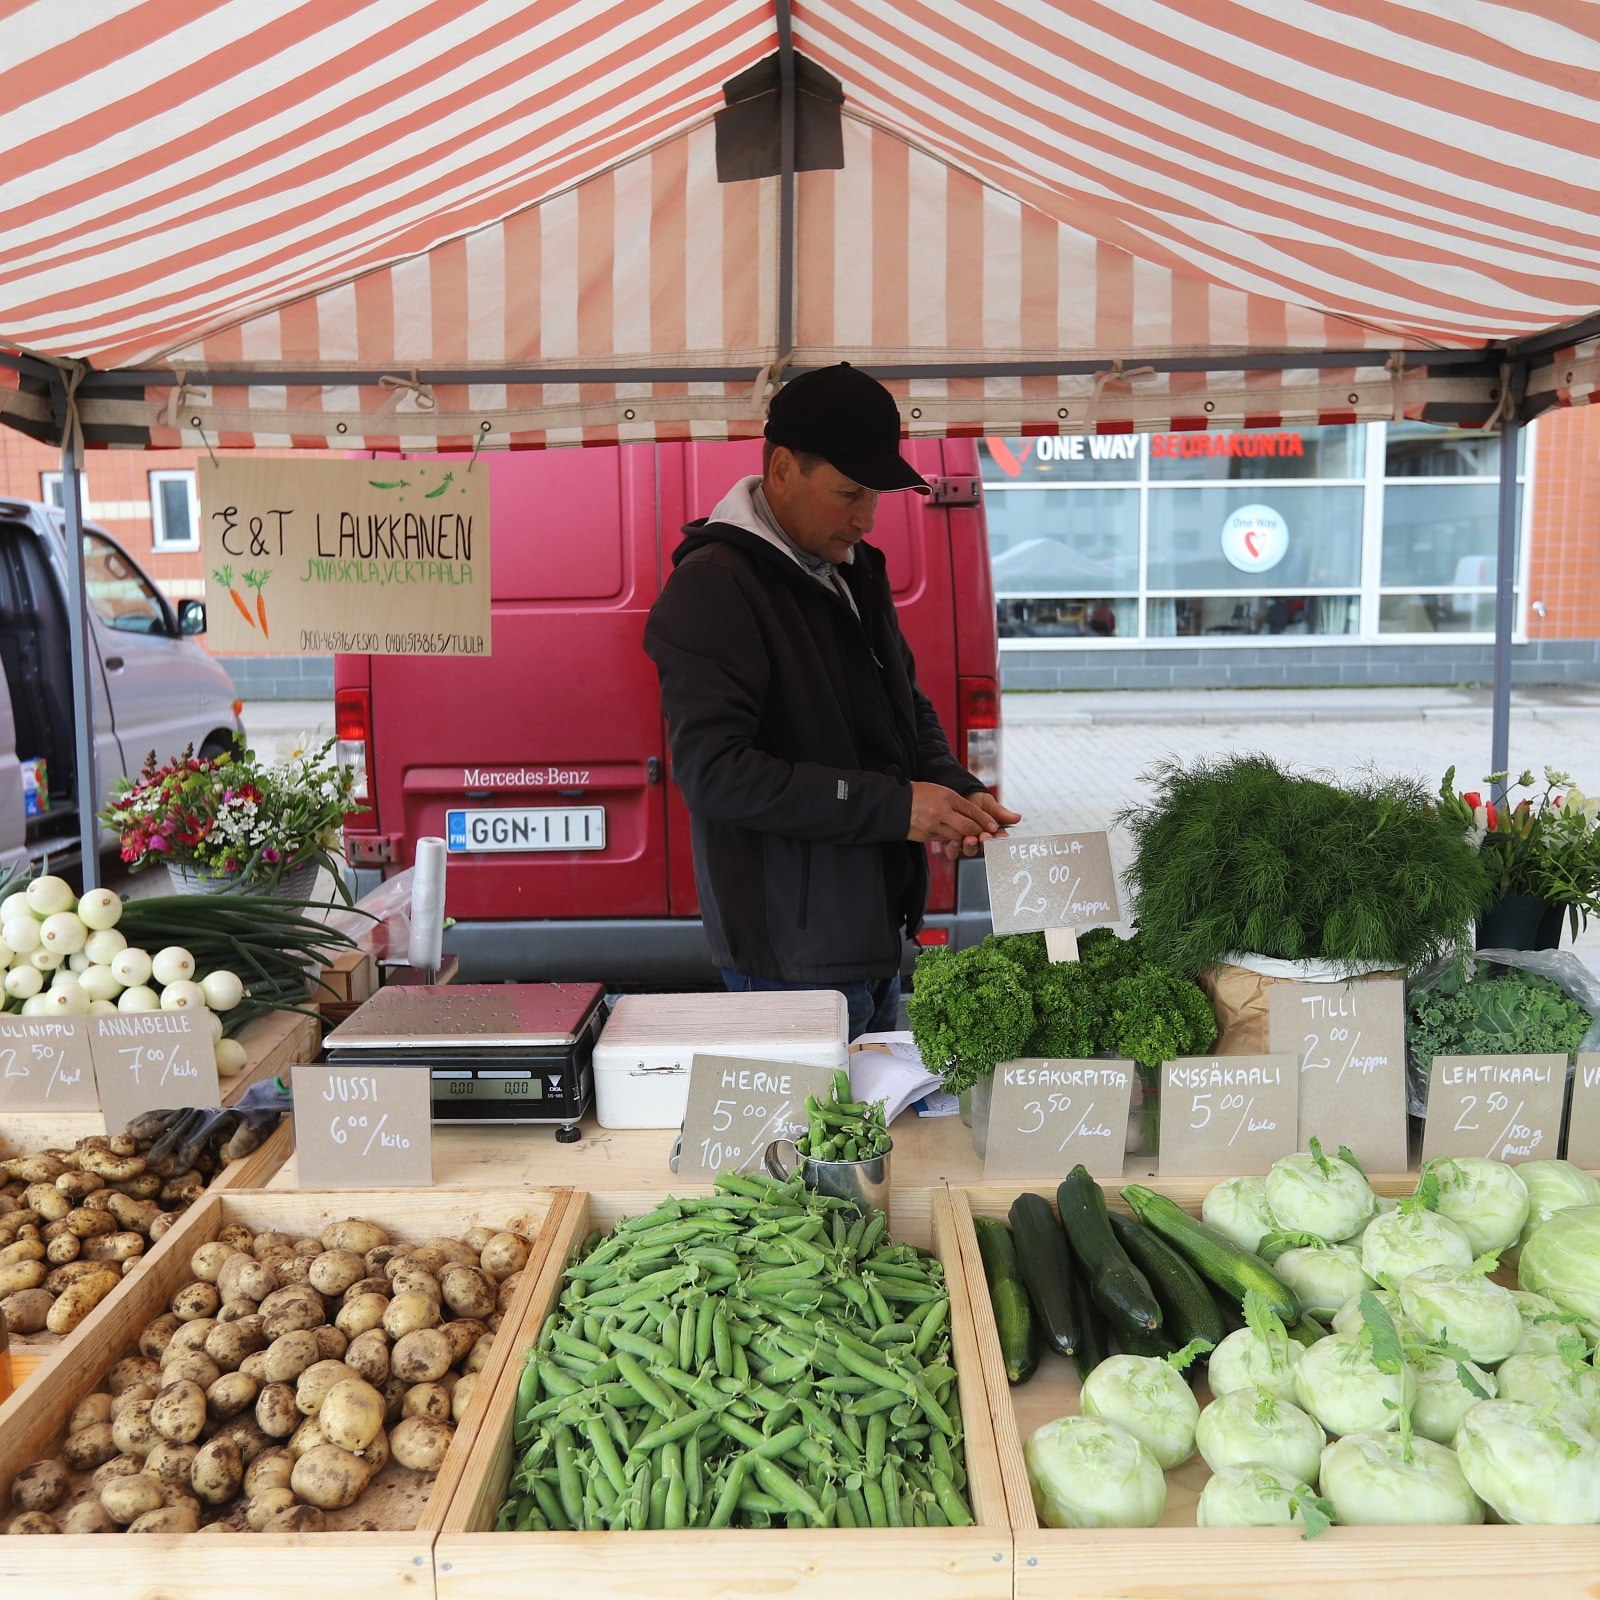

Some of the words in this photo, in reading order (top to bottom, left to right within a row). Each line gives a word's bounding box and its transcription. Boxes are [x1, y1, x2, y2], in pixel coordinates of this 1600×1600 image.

[1036, 435, 1085, 460] ONE
[1089, 435, 1139, 460] WAY
[1152, 433, 1304, 459] SEURAKUNTA
[212, 506, 293, 557] E&T
[316, 512, 472, 561] LAUKKANEN
[464, 767, 590, 787] Mercedes-Benz
[450, 834, 465, 844] FIN
[1008, 840, 1084, 860] PERSILJA
[1301, 995, 1357, 1020] TILLI
[99, 1015, 192, 1038] ANNABELLE
[323, 1075, 378, 1102] JUSSI
[721, 1068, 792, 1095] HERNE
[1004, 1062, 1129, 1090] KESÄKURPITSA
[1168, 1062, 1280, 1089] KYSSÄKAALI
[1442, 1065, 1552, 1086] LEHTIKAALI
